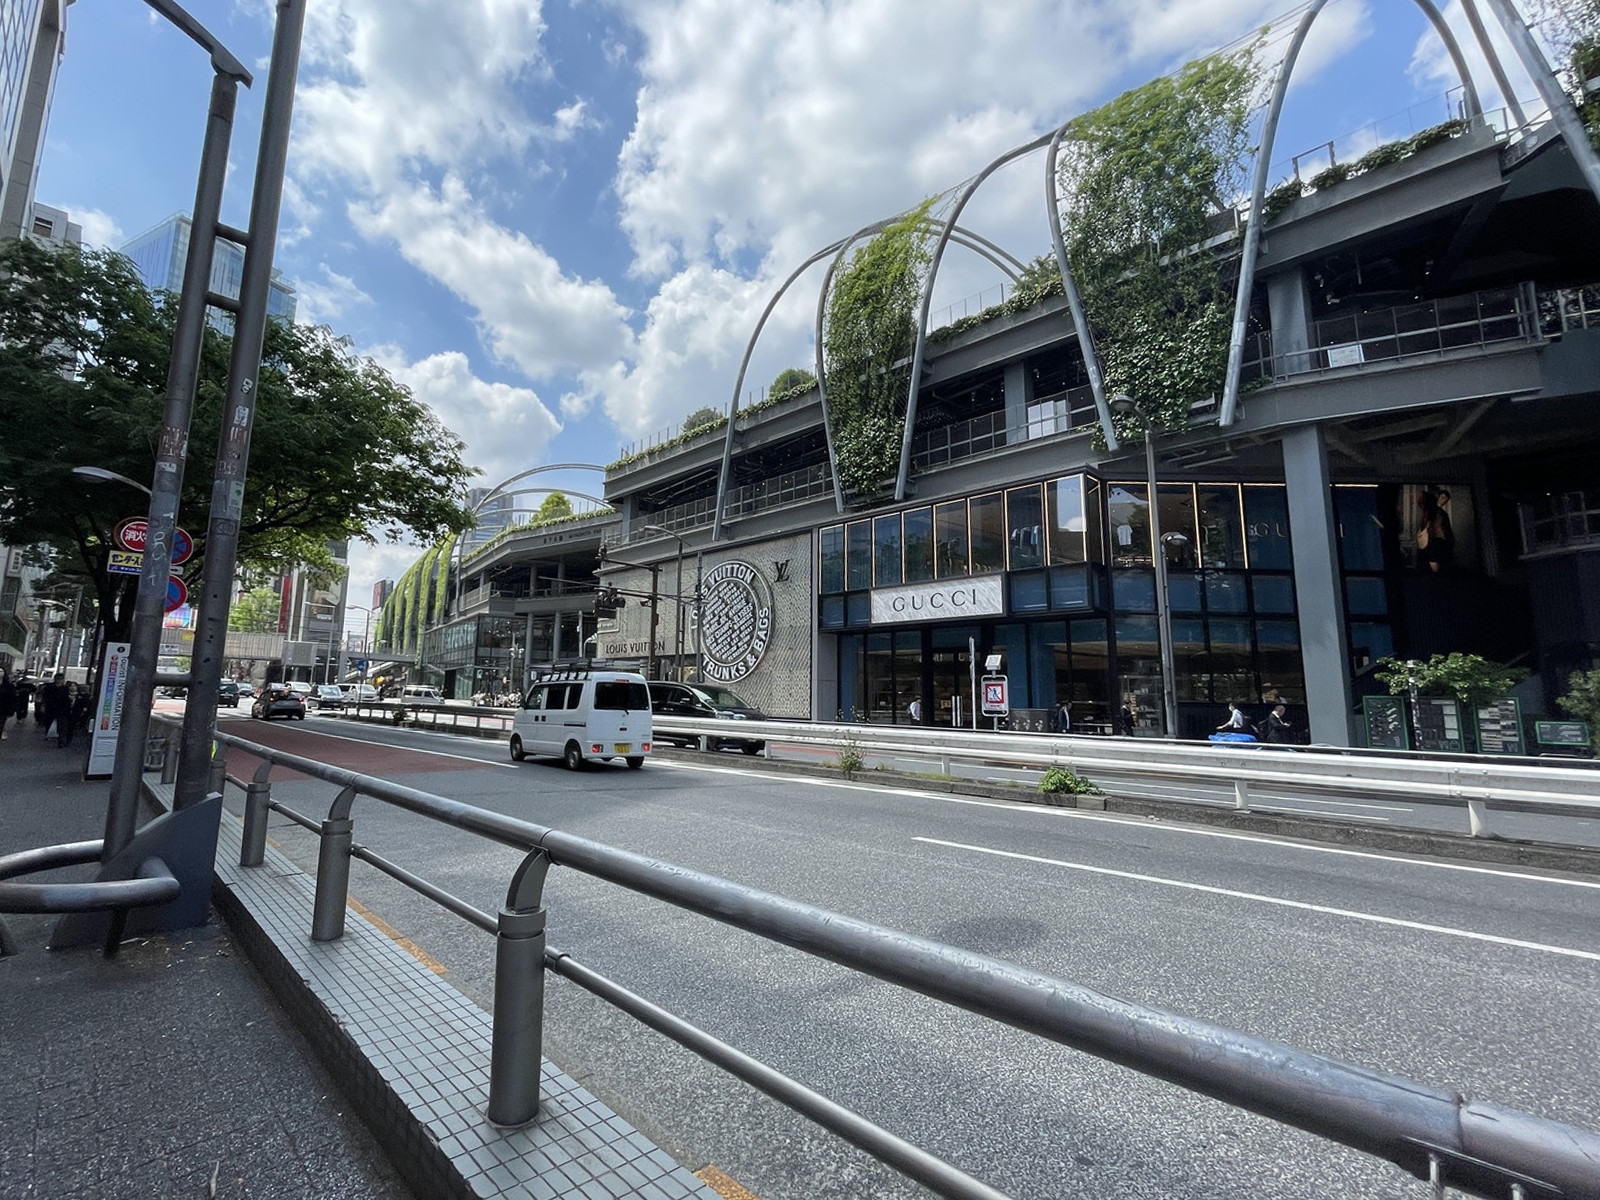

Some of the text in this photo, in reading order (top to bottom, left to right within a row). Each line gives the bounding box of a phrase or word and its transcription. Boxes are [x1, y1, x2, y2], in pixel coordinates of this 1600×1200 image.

[124, 529, 147, 542] 消火
[708, 564, 755, 586] VUITTON
[892, 588, 976, 612] GUCCI
[606, 641, 665, 654] LOUIS VUITON
[702, 654, 746, 680] TRUNKS
[746, 653, 757, 667] &
[753, 607, 769, 653] BAGS
